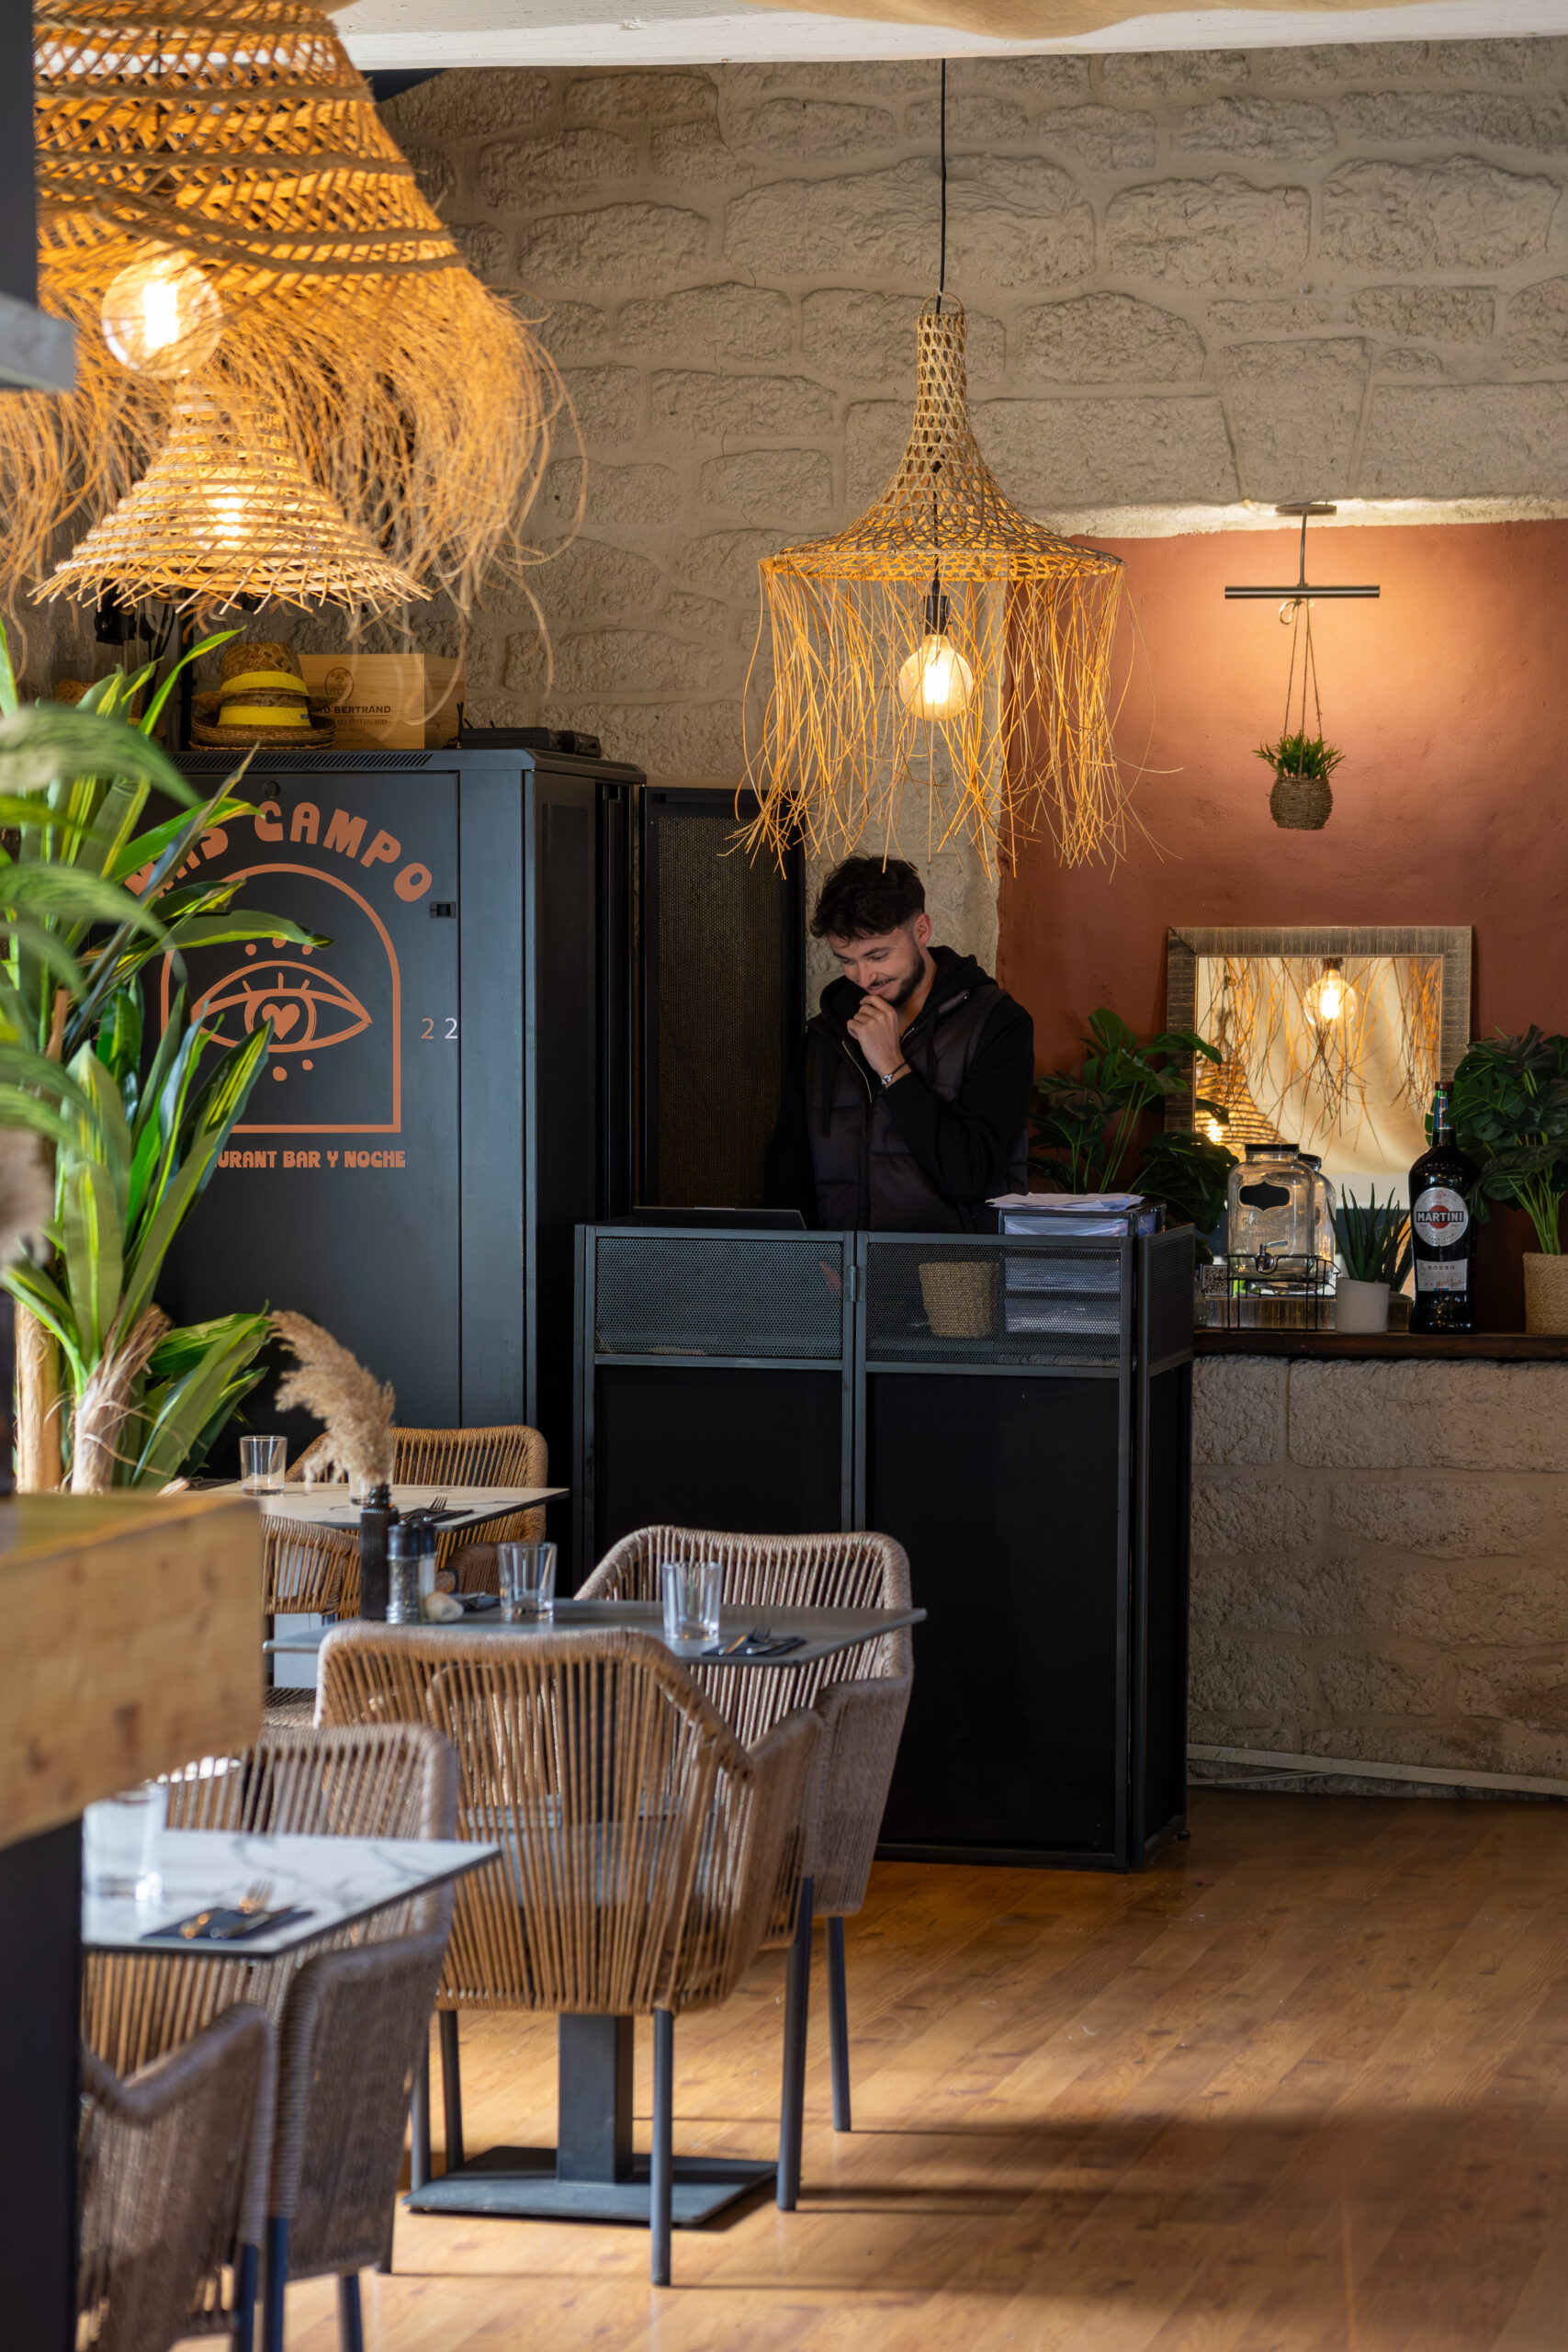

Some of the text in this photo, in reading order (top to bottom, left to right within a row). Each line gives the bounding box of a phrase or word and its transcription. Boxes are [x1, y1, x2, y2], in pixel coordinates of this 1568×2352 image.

[334, 706, 391, 714] BERTRAND
[254, 801, 433, 902] CAMPO
[214, 1150, 406, 1169] URANT BAR Y NOCHE
[1417, 1212, 1462, 1222] MARTINI
